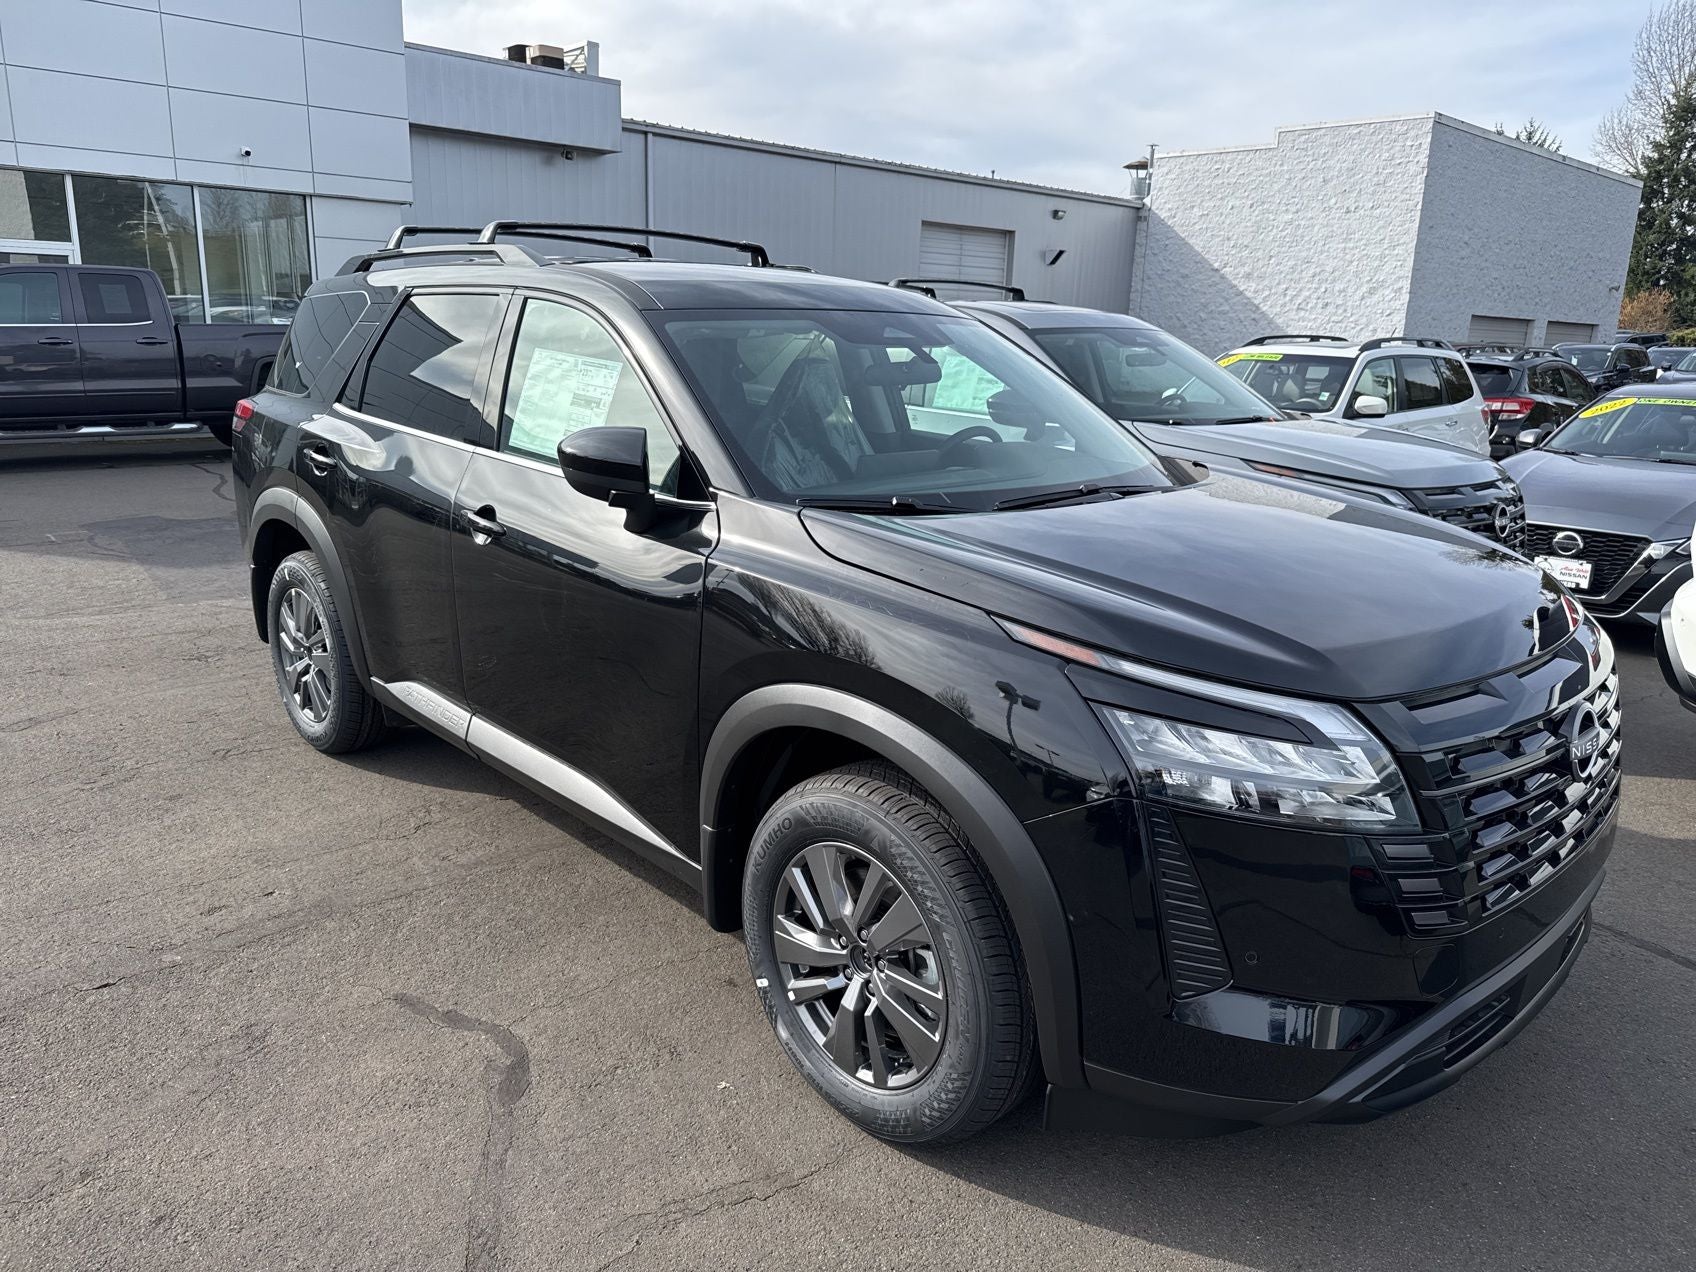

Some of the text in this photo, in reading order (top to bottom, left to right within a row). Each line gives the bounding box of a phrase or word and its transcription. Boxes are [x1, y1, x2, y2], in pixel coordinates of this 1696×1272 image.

[1559, 571, 1588, 579] NISSAN
[404, 686, 465, 727] PATHFINDER
[1571, 737, 1599, 758] NISS
[752, 817, 793, 873] KUMHO
